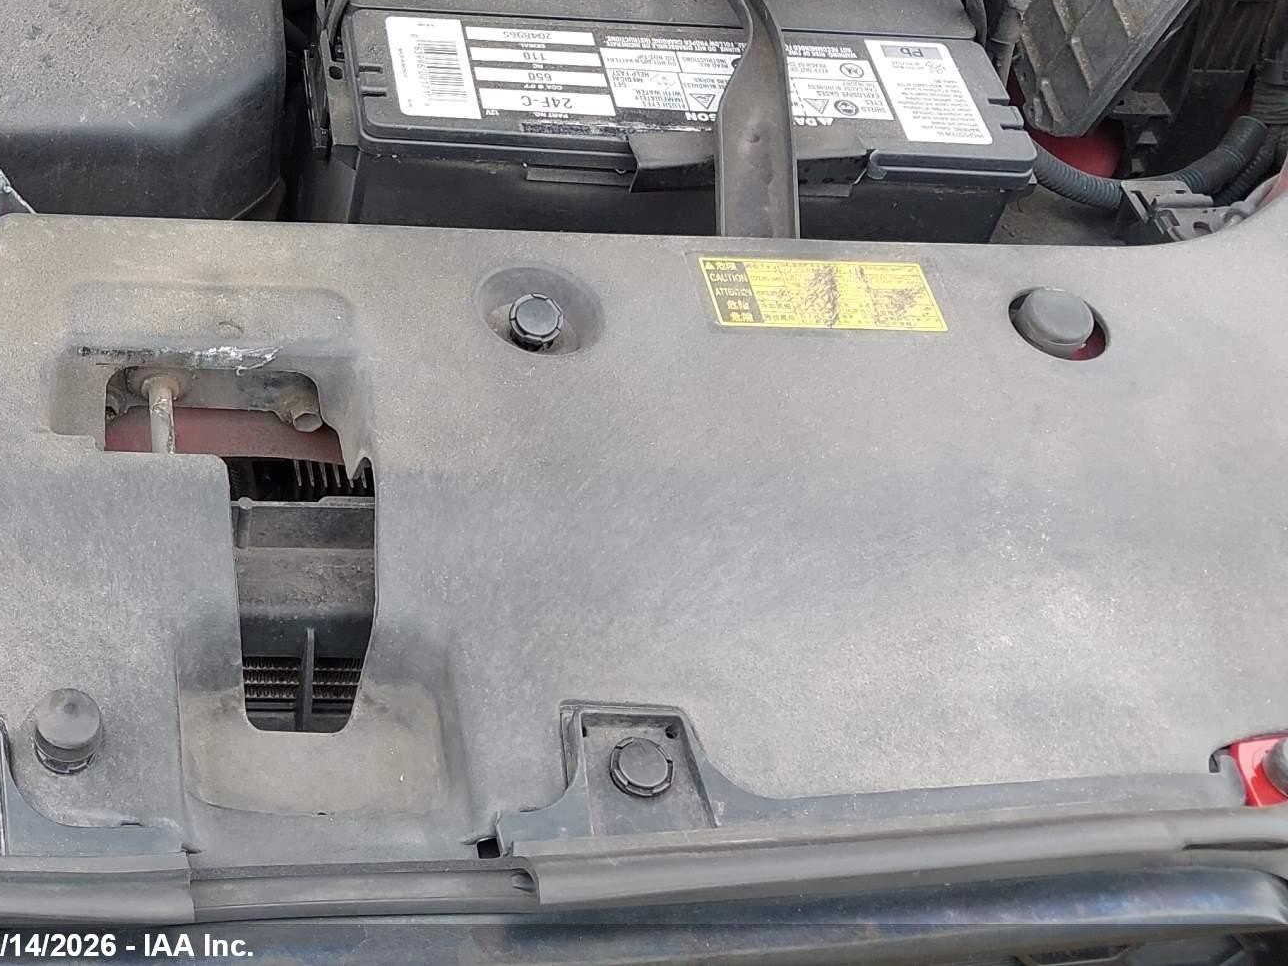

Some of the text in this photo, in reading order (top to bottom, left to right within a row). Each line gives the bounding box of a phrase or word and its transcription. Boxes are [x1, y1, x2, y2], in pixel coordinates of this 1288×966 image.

[502, 30, 553, 40] 2048965
[522, 51, 547, 62] 110
[899, 47, 924, 58] Pb
[527, 72, 552, 82] 650
[840, 91, 880, 99] EXPLOSIVE
[520, 94, 573, 109] 24F-C
[485, 108, 500, 116] 12V
[709, 273, 748, 284] CAUTION
[715, 287, 753, 297] ATTENTION
